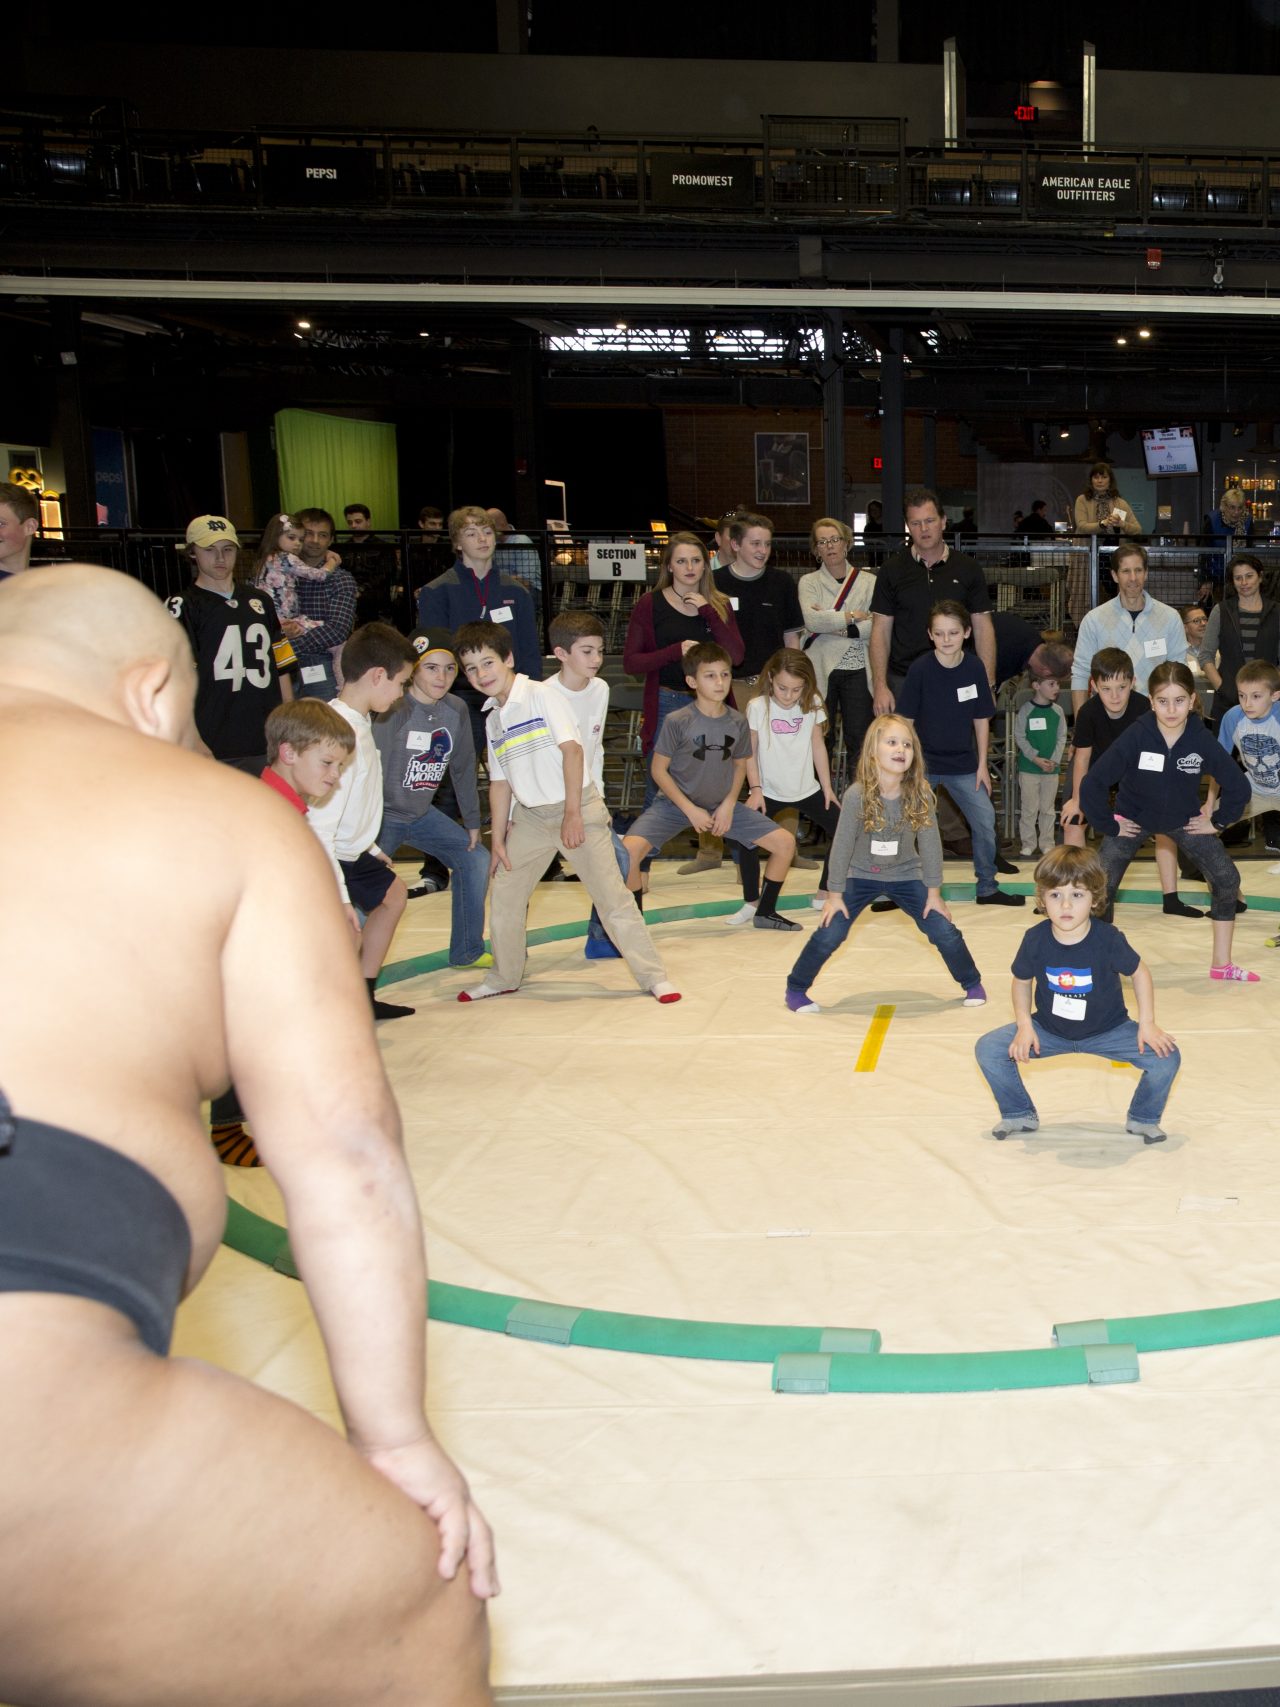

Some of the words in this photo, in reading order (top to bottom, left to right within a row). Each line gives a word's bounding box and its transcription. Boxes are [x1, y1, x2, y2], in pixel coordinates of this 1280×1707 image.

[305, 167, 337, 180] PEPSI
[672, 174, 733, 187] PROMOWEST
[1042, 177, 1094, 188] AMERICAN
[1098, 178, 1131, 189] EAGLE
[1057, 190, 1116, 201] OUTFITTERS
[96, 471, 123, 485] pepsi
[597, 548, 636, 560] SECTION
[612, 561, 622, 577] B
[213, 622, 272, 693] 43
[411, 761, 447, 772] ROBER
